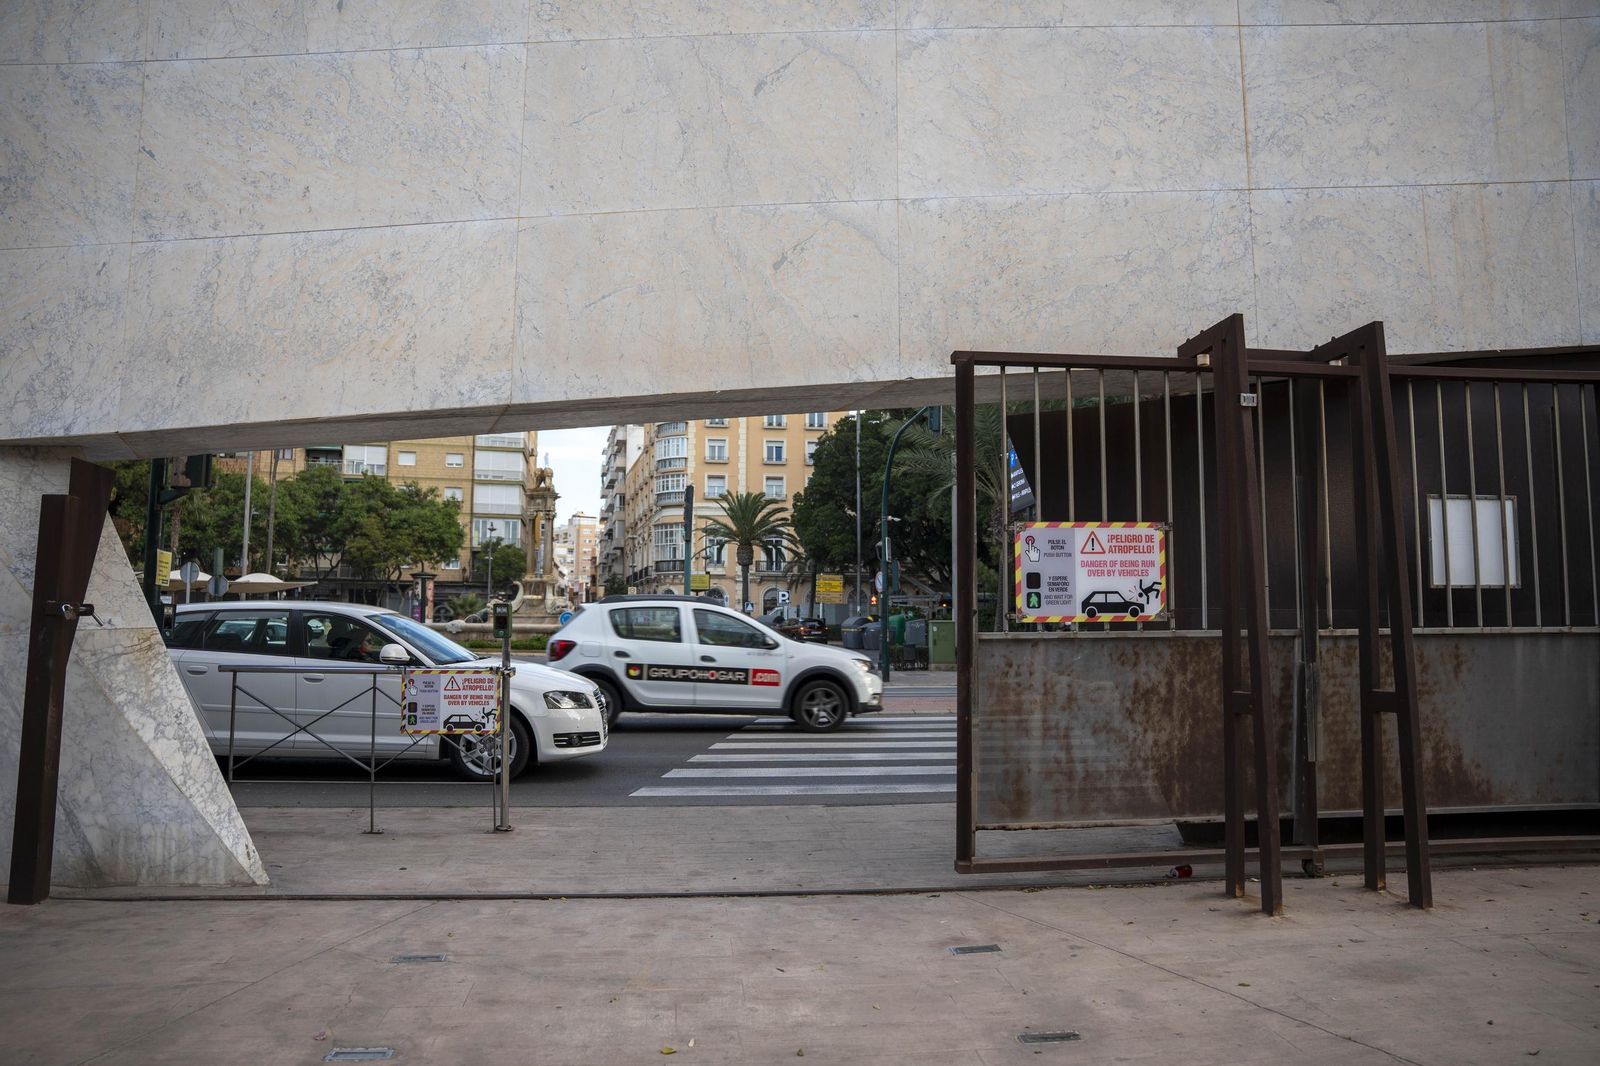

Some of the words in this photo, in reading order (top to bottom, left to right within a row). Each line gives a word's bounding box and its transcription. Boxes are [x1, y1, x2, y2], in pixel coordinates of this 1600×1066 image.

[1107, 534, 1142, 543] ¡PELIGRO
[1145, 534, 1154, 543] DE
[1108, 545, 1154, 554] ATROPELLO!
